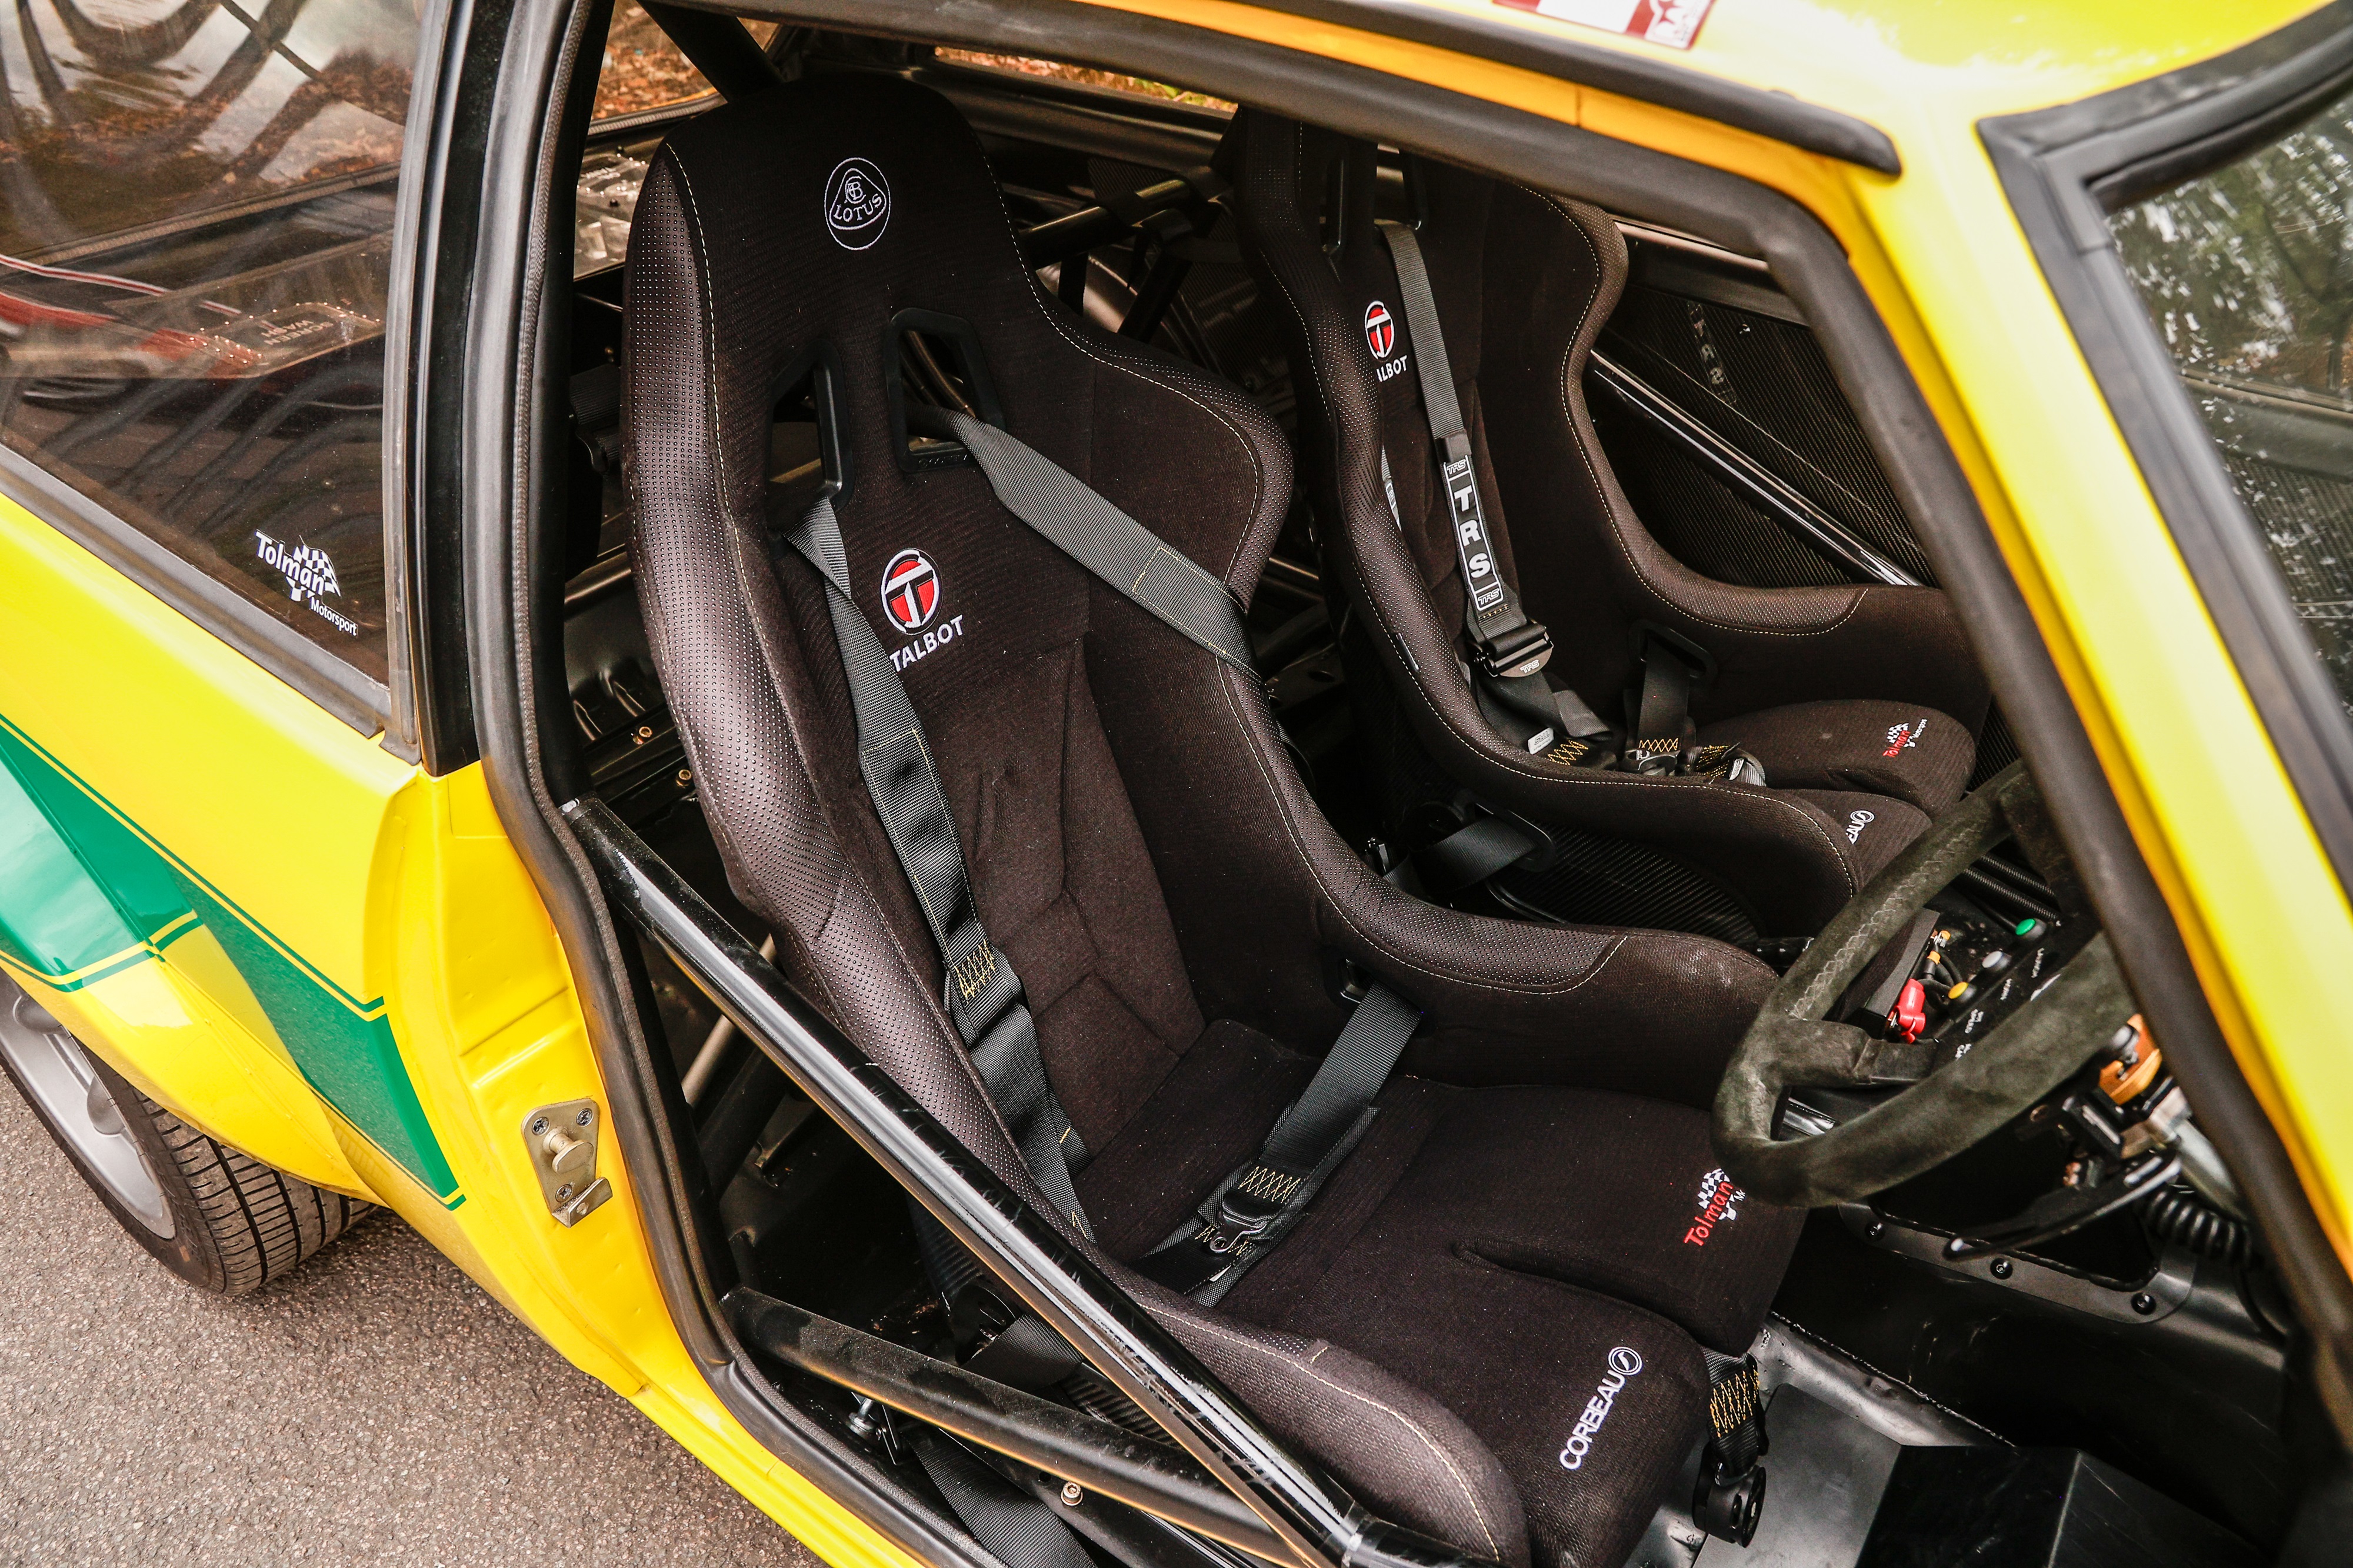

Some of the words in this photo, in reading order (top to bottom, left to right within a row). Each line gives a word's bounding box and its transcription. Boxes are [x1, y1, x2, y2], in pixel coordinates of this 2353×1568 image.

[833, 193, 883, 222] LOTUS
[1447, 459, 1467, 475] TRS
[255, 529, 325, 596] Tolman
[1478, 588, 1500, 605] TRS
[310, 596, 358, 636] Motorsport
[889, 614, 964, 672] TALBOT
[1519, 659, 1540, 673] TRS
[1882, 730, 1911, 758] Tolman
[1683, 1182, 1734, 1246] Tolman
[1559, 1369, 1627, 1470] CORBEAU
